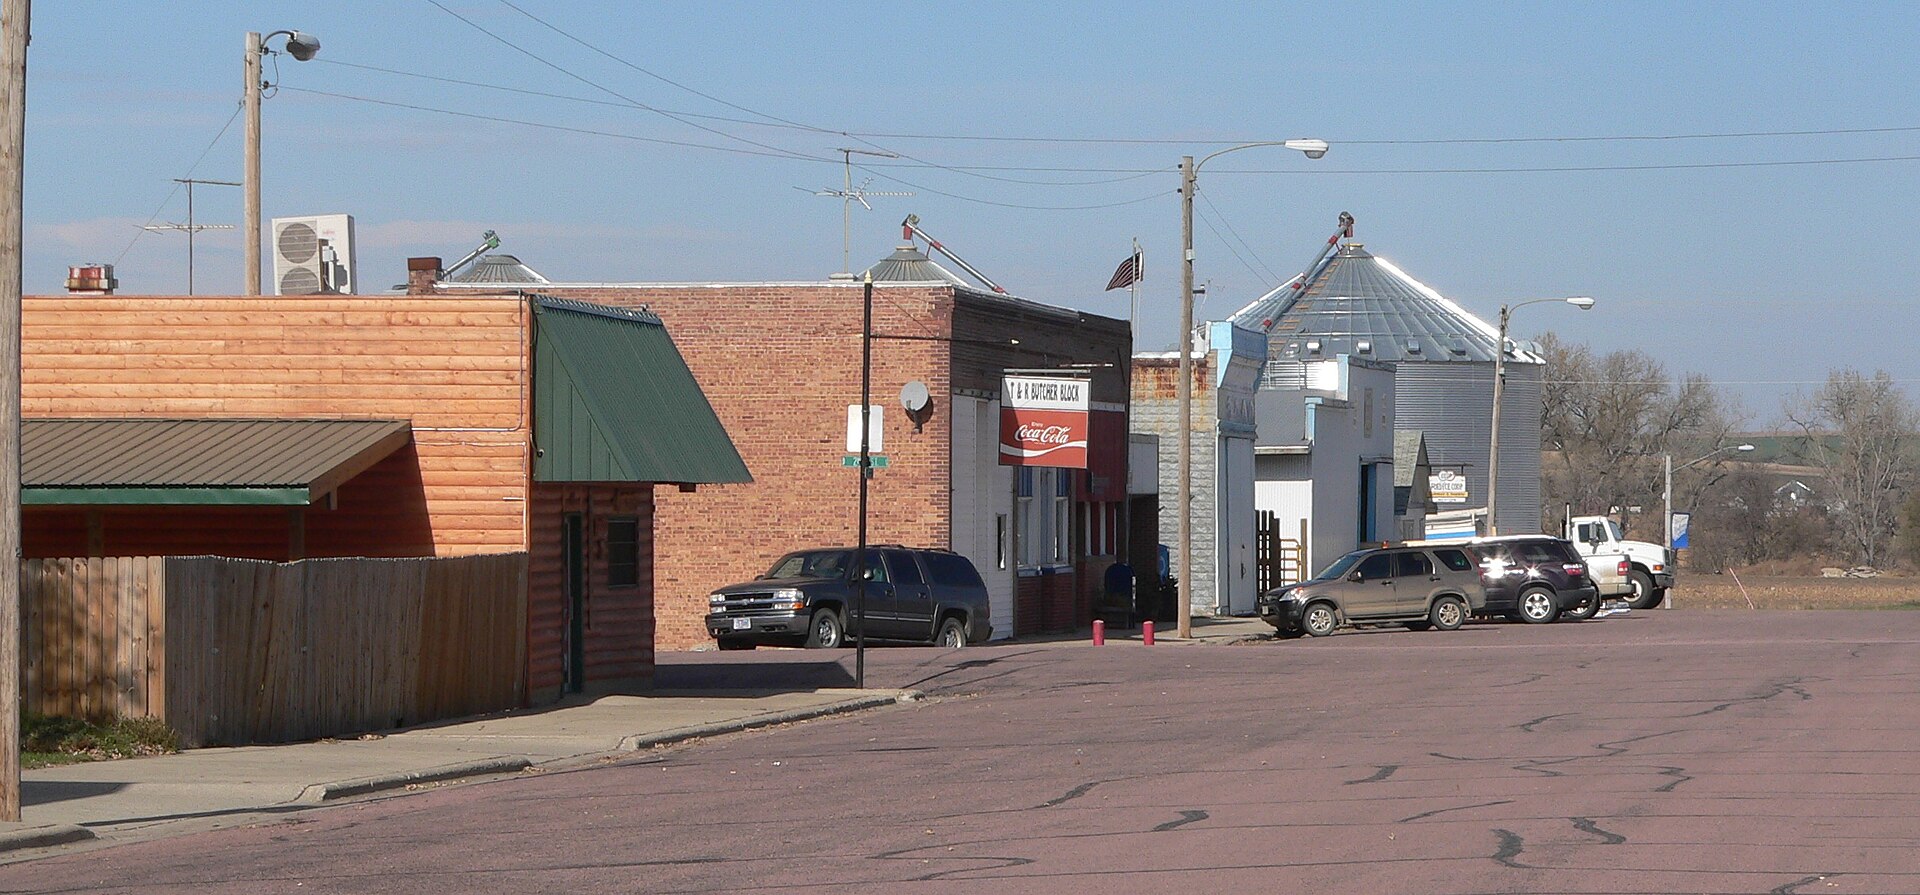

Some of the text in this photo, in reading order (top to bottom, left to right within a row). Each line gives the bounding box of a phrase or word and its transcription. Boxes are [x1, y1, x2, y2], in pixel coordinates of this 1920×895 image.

[1010, 381, 1079, 402] T & R BUTCHER BLOCK
[1014, 424, 1072, 444] Coca-Cola
